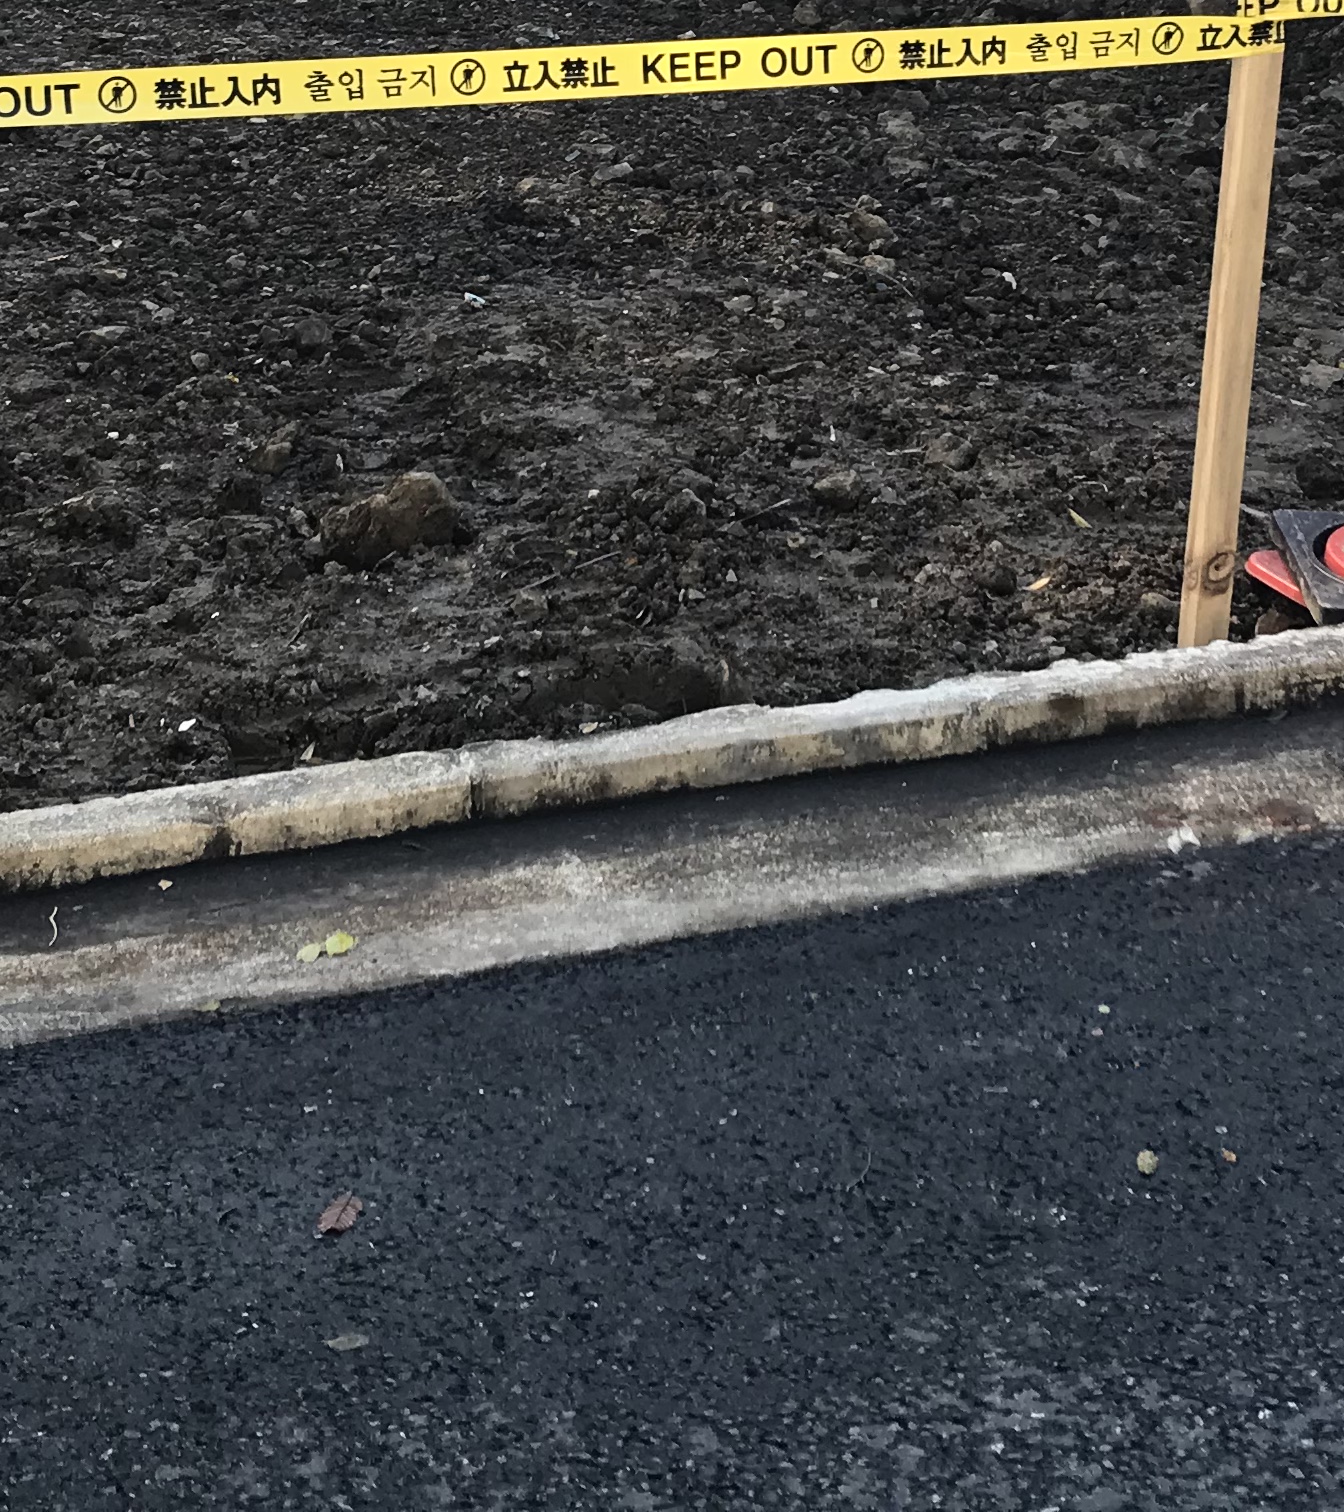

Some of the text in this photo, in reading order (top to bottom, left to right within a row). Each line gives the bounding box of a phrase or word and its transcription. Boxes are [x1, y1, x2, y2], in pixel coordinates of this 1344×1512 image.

[153, 72, 281, 111] 禁止入内
[304, 68, 364, 102] 출입
[377, 64, 436, 98] 금지
[502, 56, 619, 93] 立入禁止
[642, 50, 741, 85] KEEP
[761, 44, 837, 78] OUT
[898, 35, 1006, 70] 禁止入内
[1026, 31, 1078, 62] 출입
[1089, 27, 1140, 59] 금지
